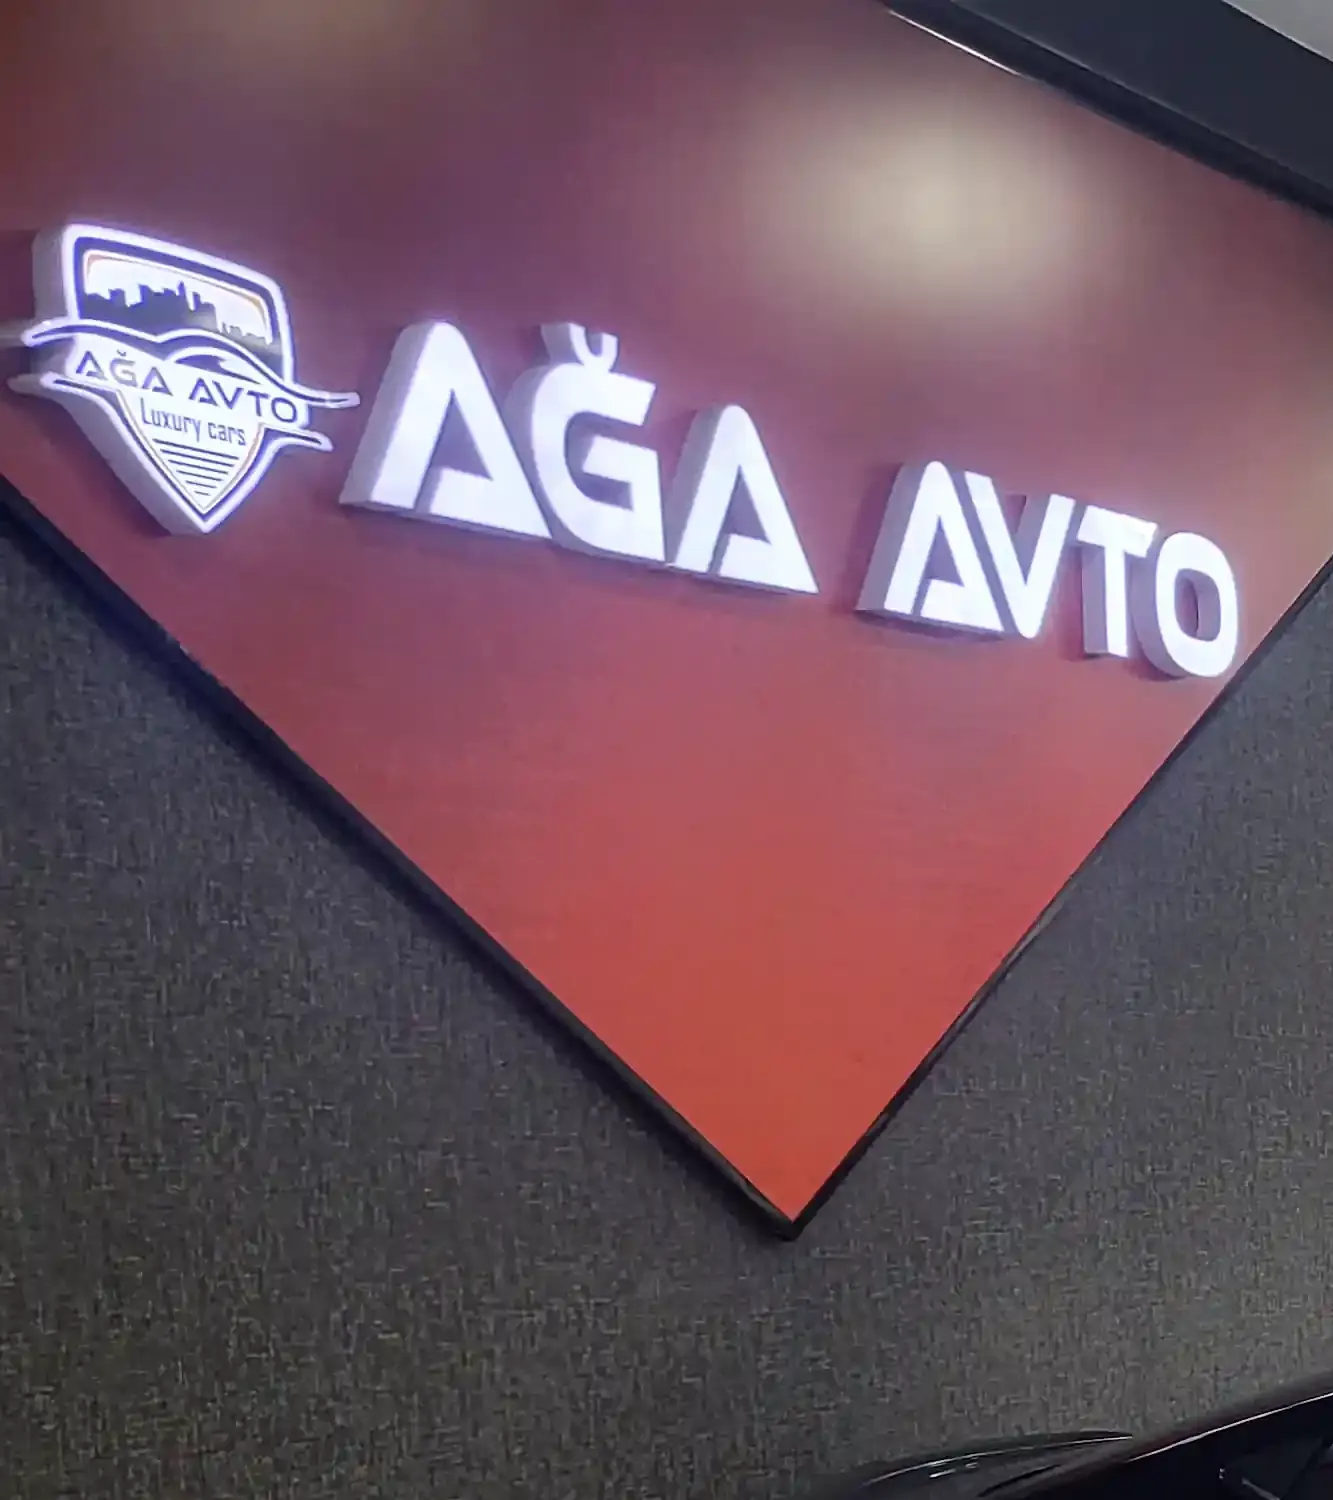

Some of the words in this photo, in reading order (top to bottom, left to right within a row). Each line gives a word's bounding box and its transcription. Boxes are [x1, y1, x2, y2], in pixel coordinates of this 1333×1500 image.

[75, 350, 174, 396] AĞA
[188, 377, 298, 424] AVTO
[139, 396, 202, 443] Luxury
[207, 420, 247, 446] cars
[342, 320, 819, 595] AĞA
[857, 459, 1239, 678] AVTO
